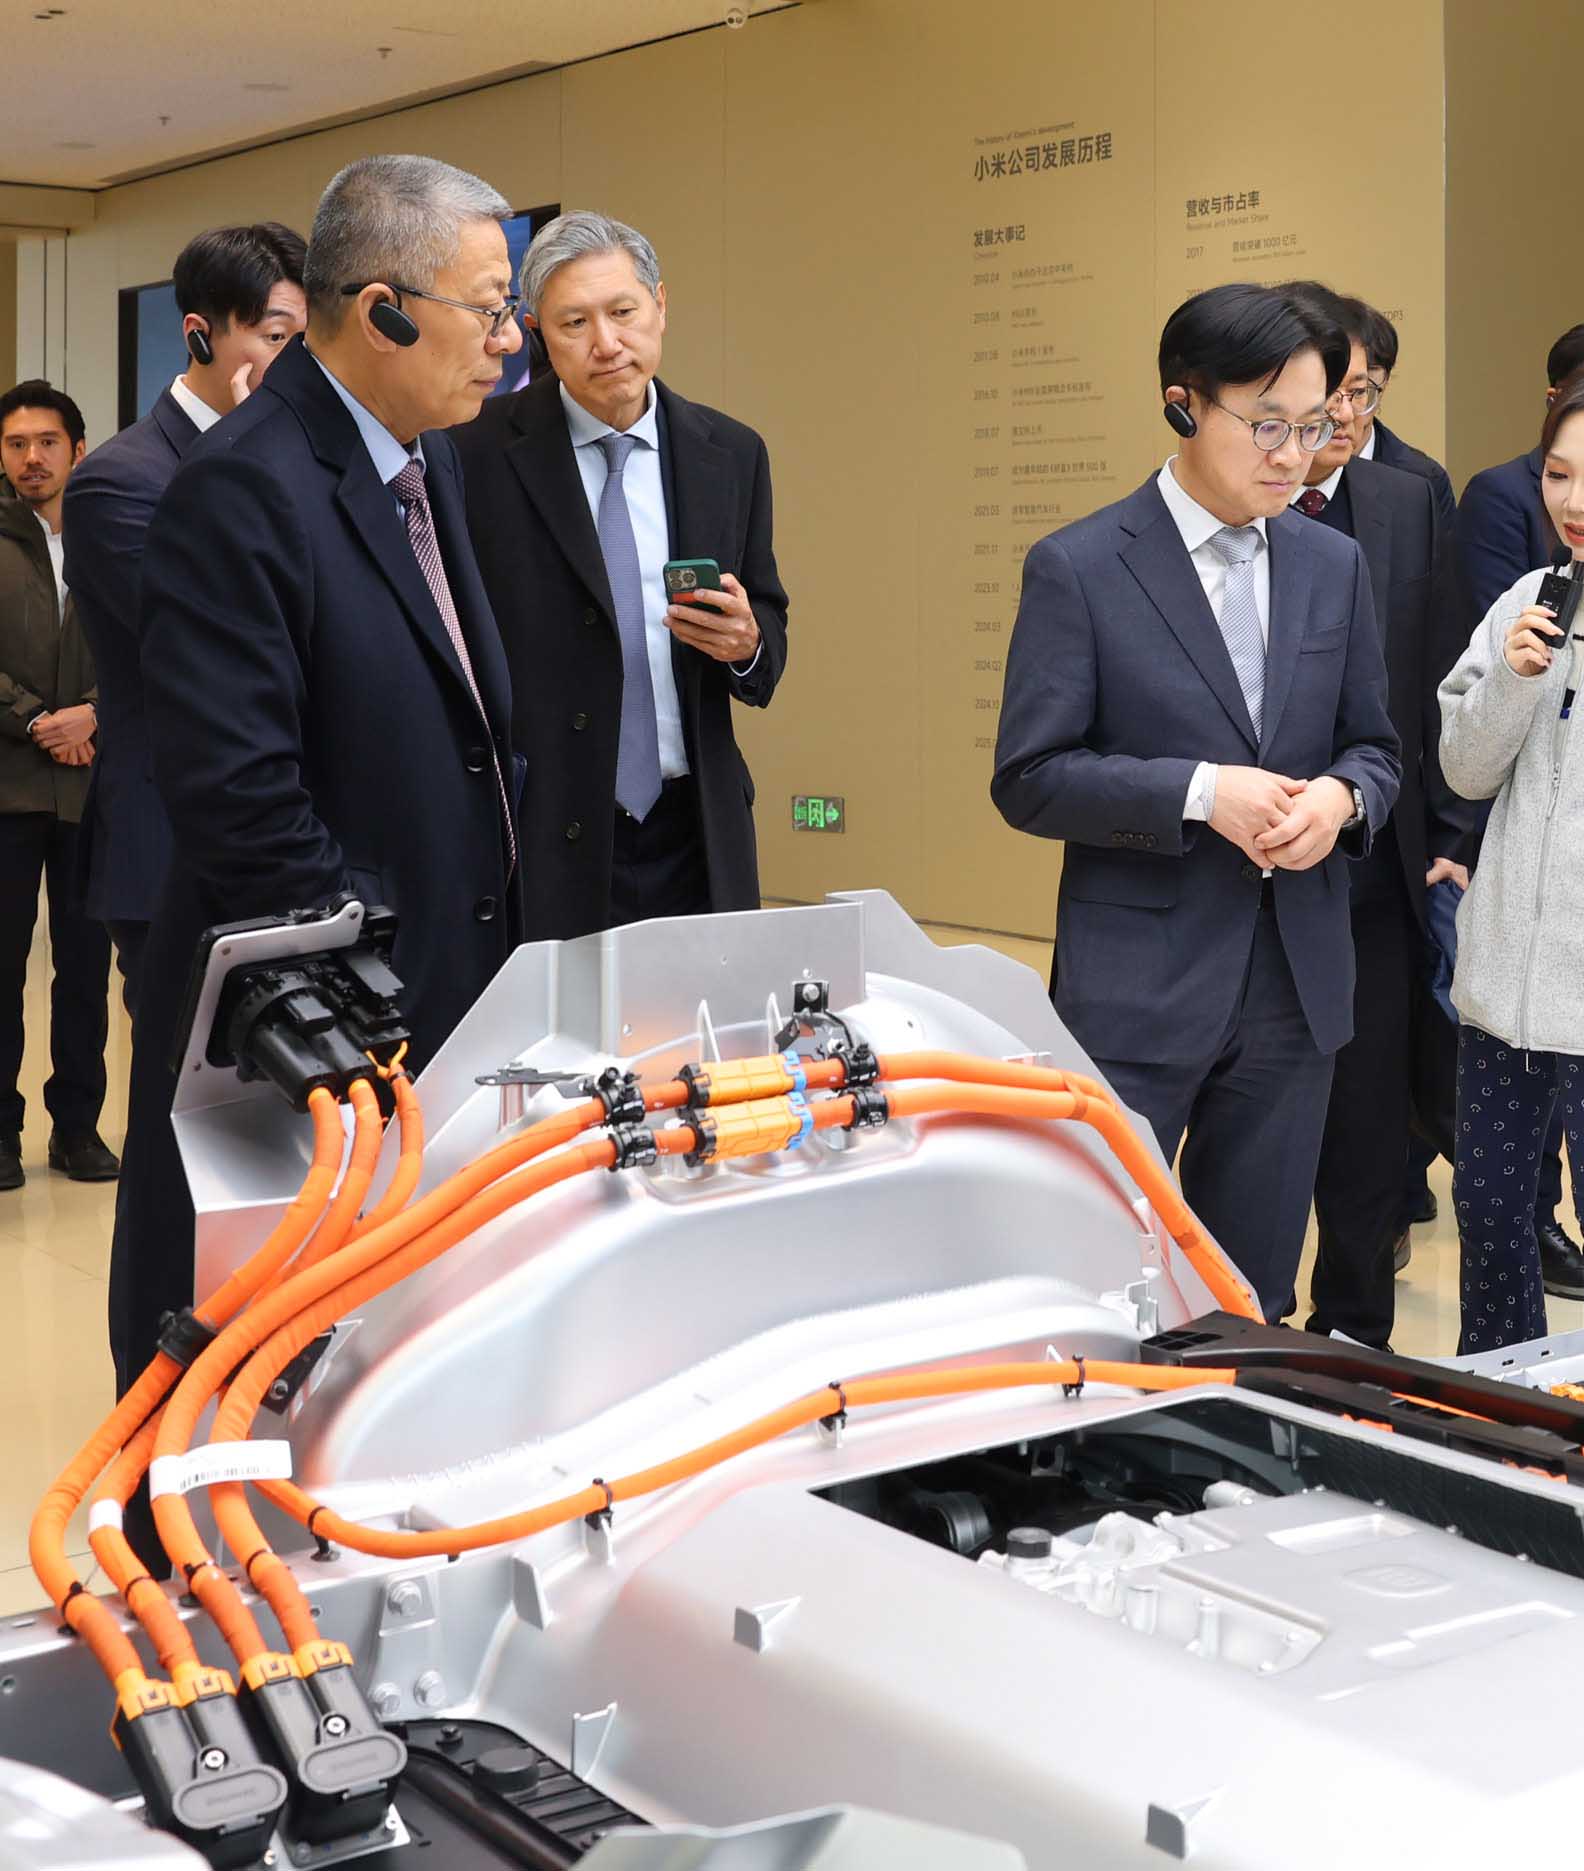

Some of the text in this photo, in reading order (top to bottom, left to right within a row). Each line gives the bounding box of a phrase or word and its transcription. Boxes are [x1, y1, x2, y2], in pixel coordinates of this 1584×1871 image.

[974, 132, 1113, 182] 小米公司发展历程
[1186, 190, 1261, 218] 营收与市占率
[974, 224, 1026, 248] 发展大事记
